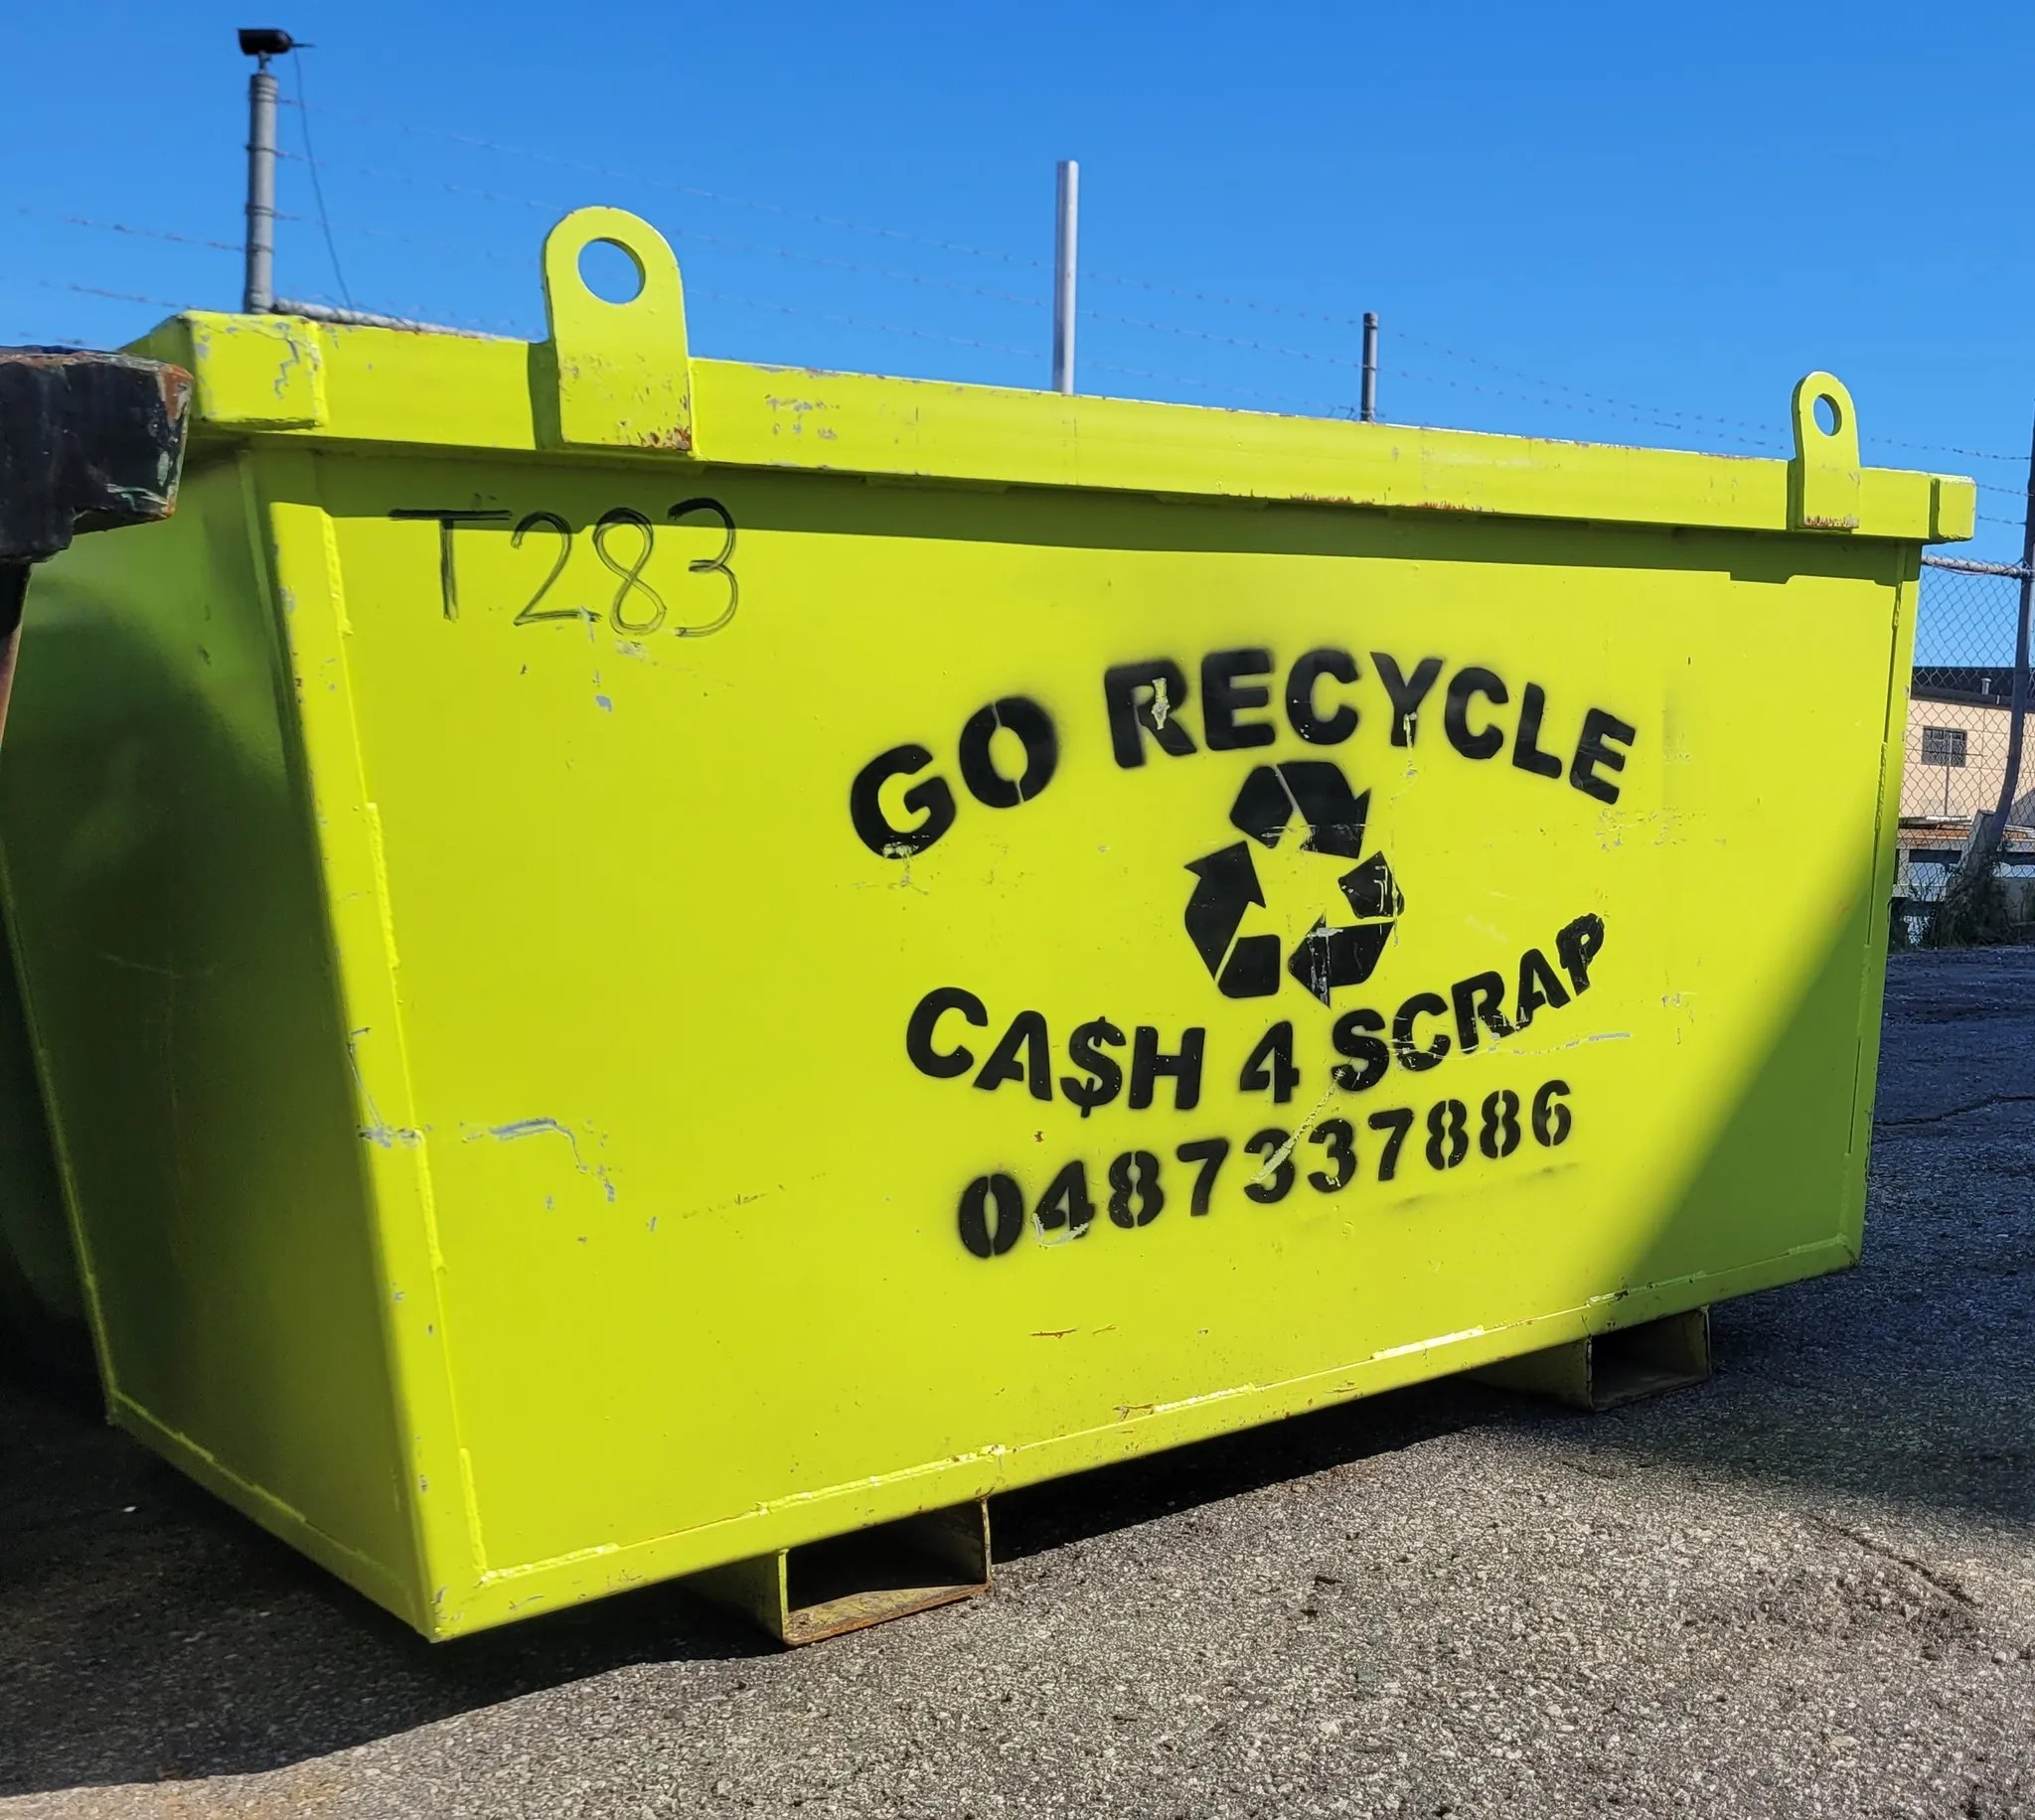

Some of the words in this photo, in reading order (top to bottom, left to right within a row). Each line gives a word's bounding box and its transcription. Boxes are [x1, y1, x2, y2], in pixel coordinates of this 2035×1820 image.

[388, 497, 738, 637] T283
[850, 695, 1060, 860] GO
[1104, 648, 1637, 805] RECYCLE
[905, 986, 1206, 1118] CA$H
[1239, 1019, 1300, 1105] 4
[1331, 912, 1606, 1092] SCRAP
[958, 1079, 1572, 1259] 0487337886
